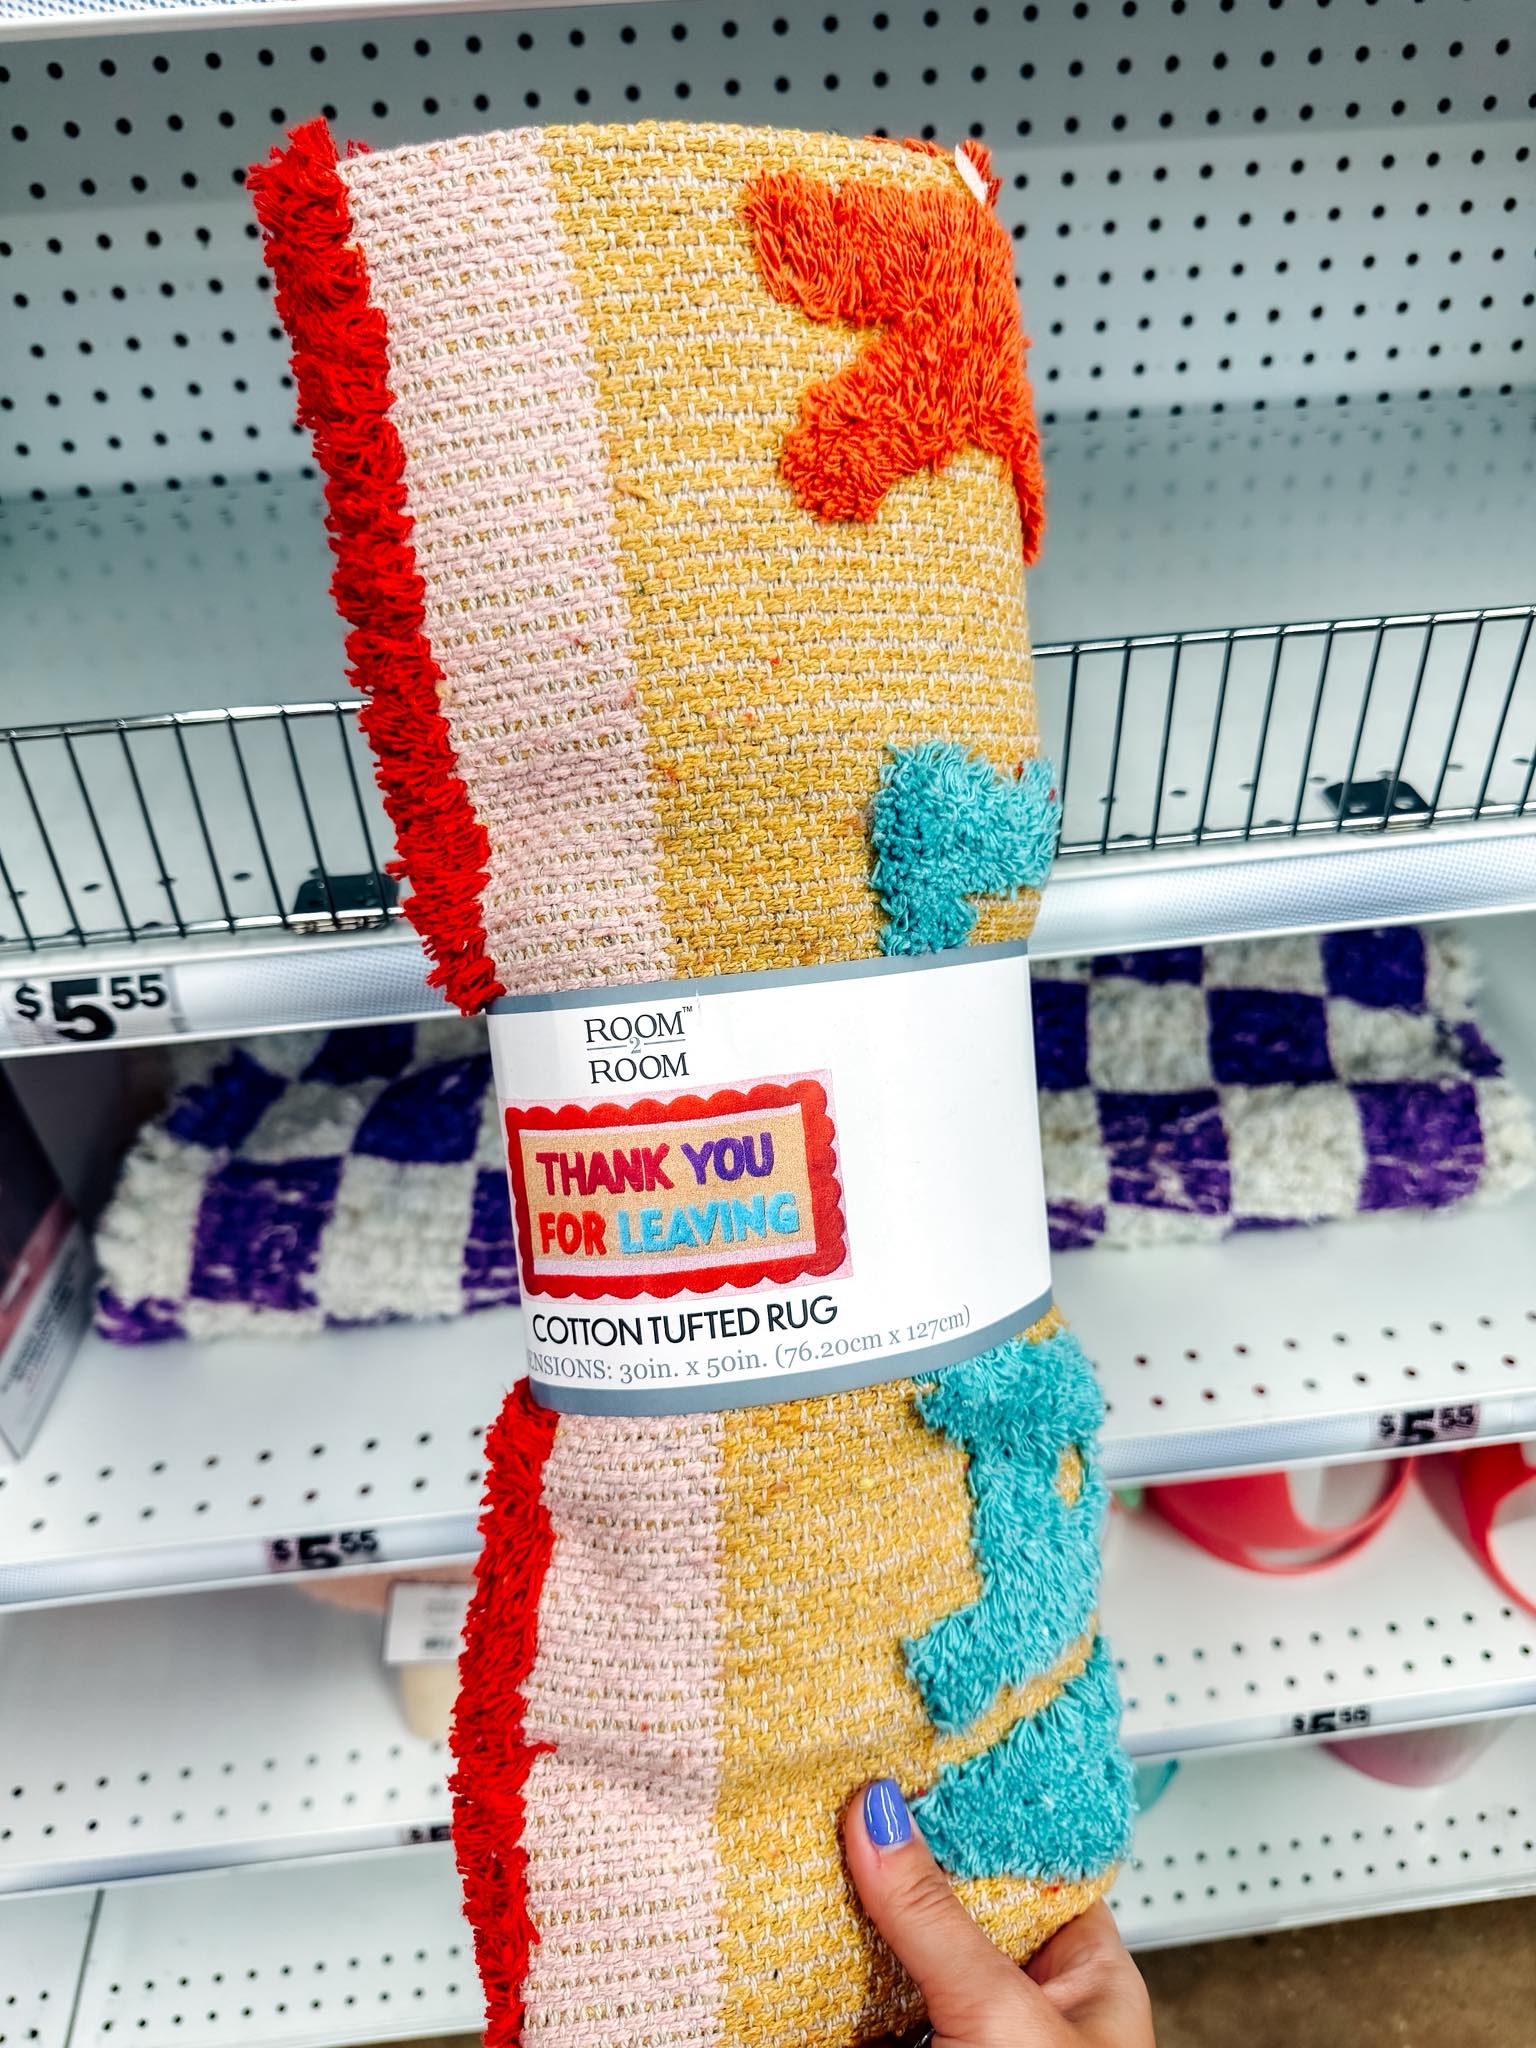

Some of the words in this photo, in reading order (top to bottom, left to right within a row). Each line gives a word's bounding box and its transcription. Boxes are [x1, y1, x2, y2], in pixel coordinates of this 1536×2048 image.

[588, 1051, 690, 1084] ROOM
[629, 1036, 642, 1054] 2
[535, 1142, 675, 1197] THANK
[680, 1131, 775, 1185] YOU
[538, 1210, 608, 1256] FOR
[616, 1190, 800, 1255] LEAVING
[532, 1313, 643, 1347] COTTON
[647, 1307, 761, 1344] TUFTED
[766, 1294, 838, 1332] RUG
[619, 1358, 679, 1384] 30in.
[686, 1361, 701, 1376] x
[707, 1349, 768, 1379] 50in.
[775, 1330, 882, 1369] (76.20cm
[888, 1328, 902, 1346] x
[907, 1303, 971, 1341] 127cm)
